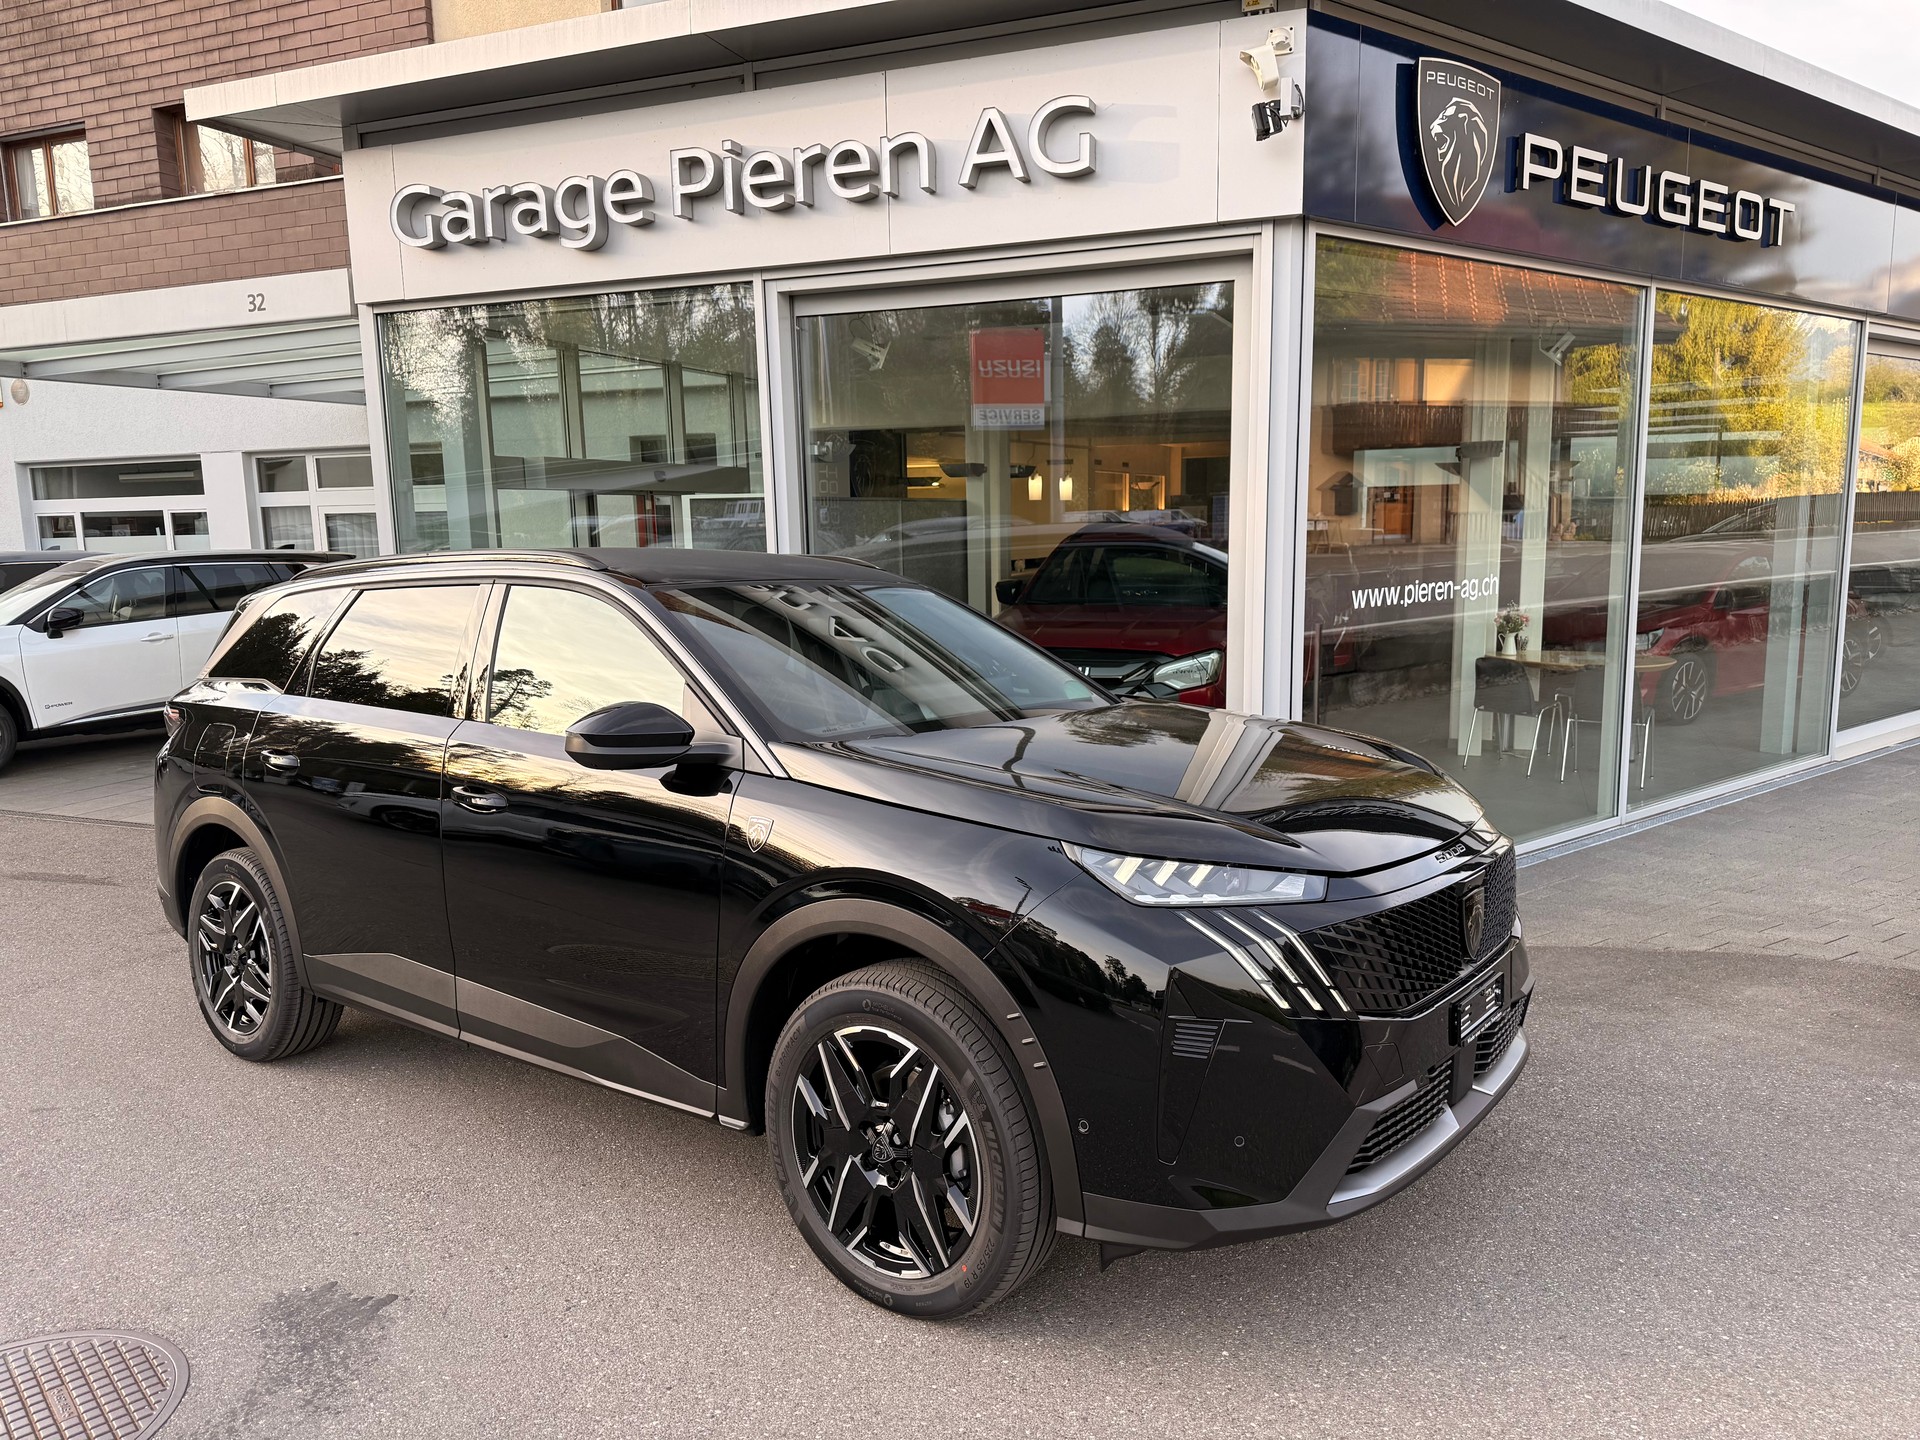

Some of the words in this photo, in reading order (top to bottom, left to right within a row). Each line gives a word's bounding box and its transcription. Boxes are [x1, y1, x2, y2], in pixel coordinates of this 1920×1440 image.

[1426, 70, 1495, 101] PEUGEOT
[389, 169, 655, 250] Garage
[670, 131, 937, 220] Pieren
[958, 95, 1097, 189] AG
[1521, 132, 1796, 247] PEUGEOT
[247, 293, 267, 312] 32
[1351, 573, 1499, 610] www.pieren-ag.ch
[1434, 843, 1466, 864] 5008
[768, 1086, 786, 1182] MICHELIN
[980, 1120, 1005, 1229] MICHELIN
[976, 1237, 995, 1274] 225/55
[963, 1278, 973, 1289] 19
[970, 1270, 979, 1280] R
